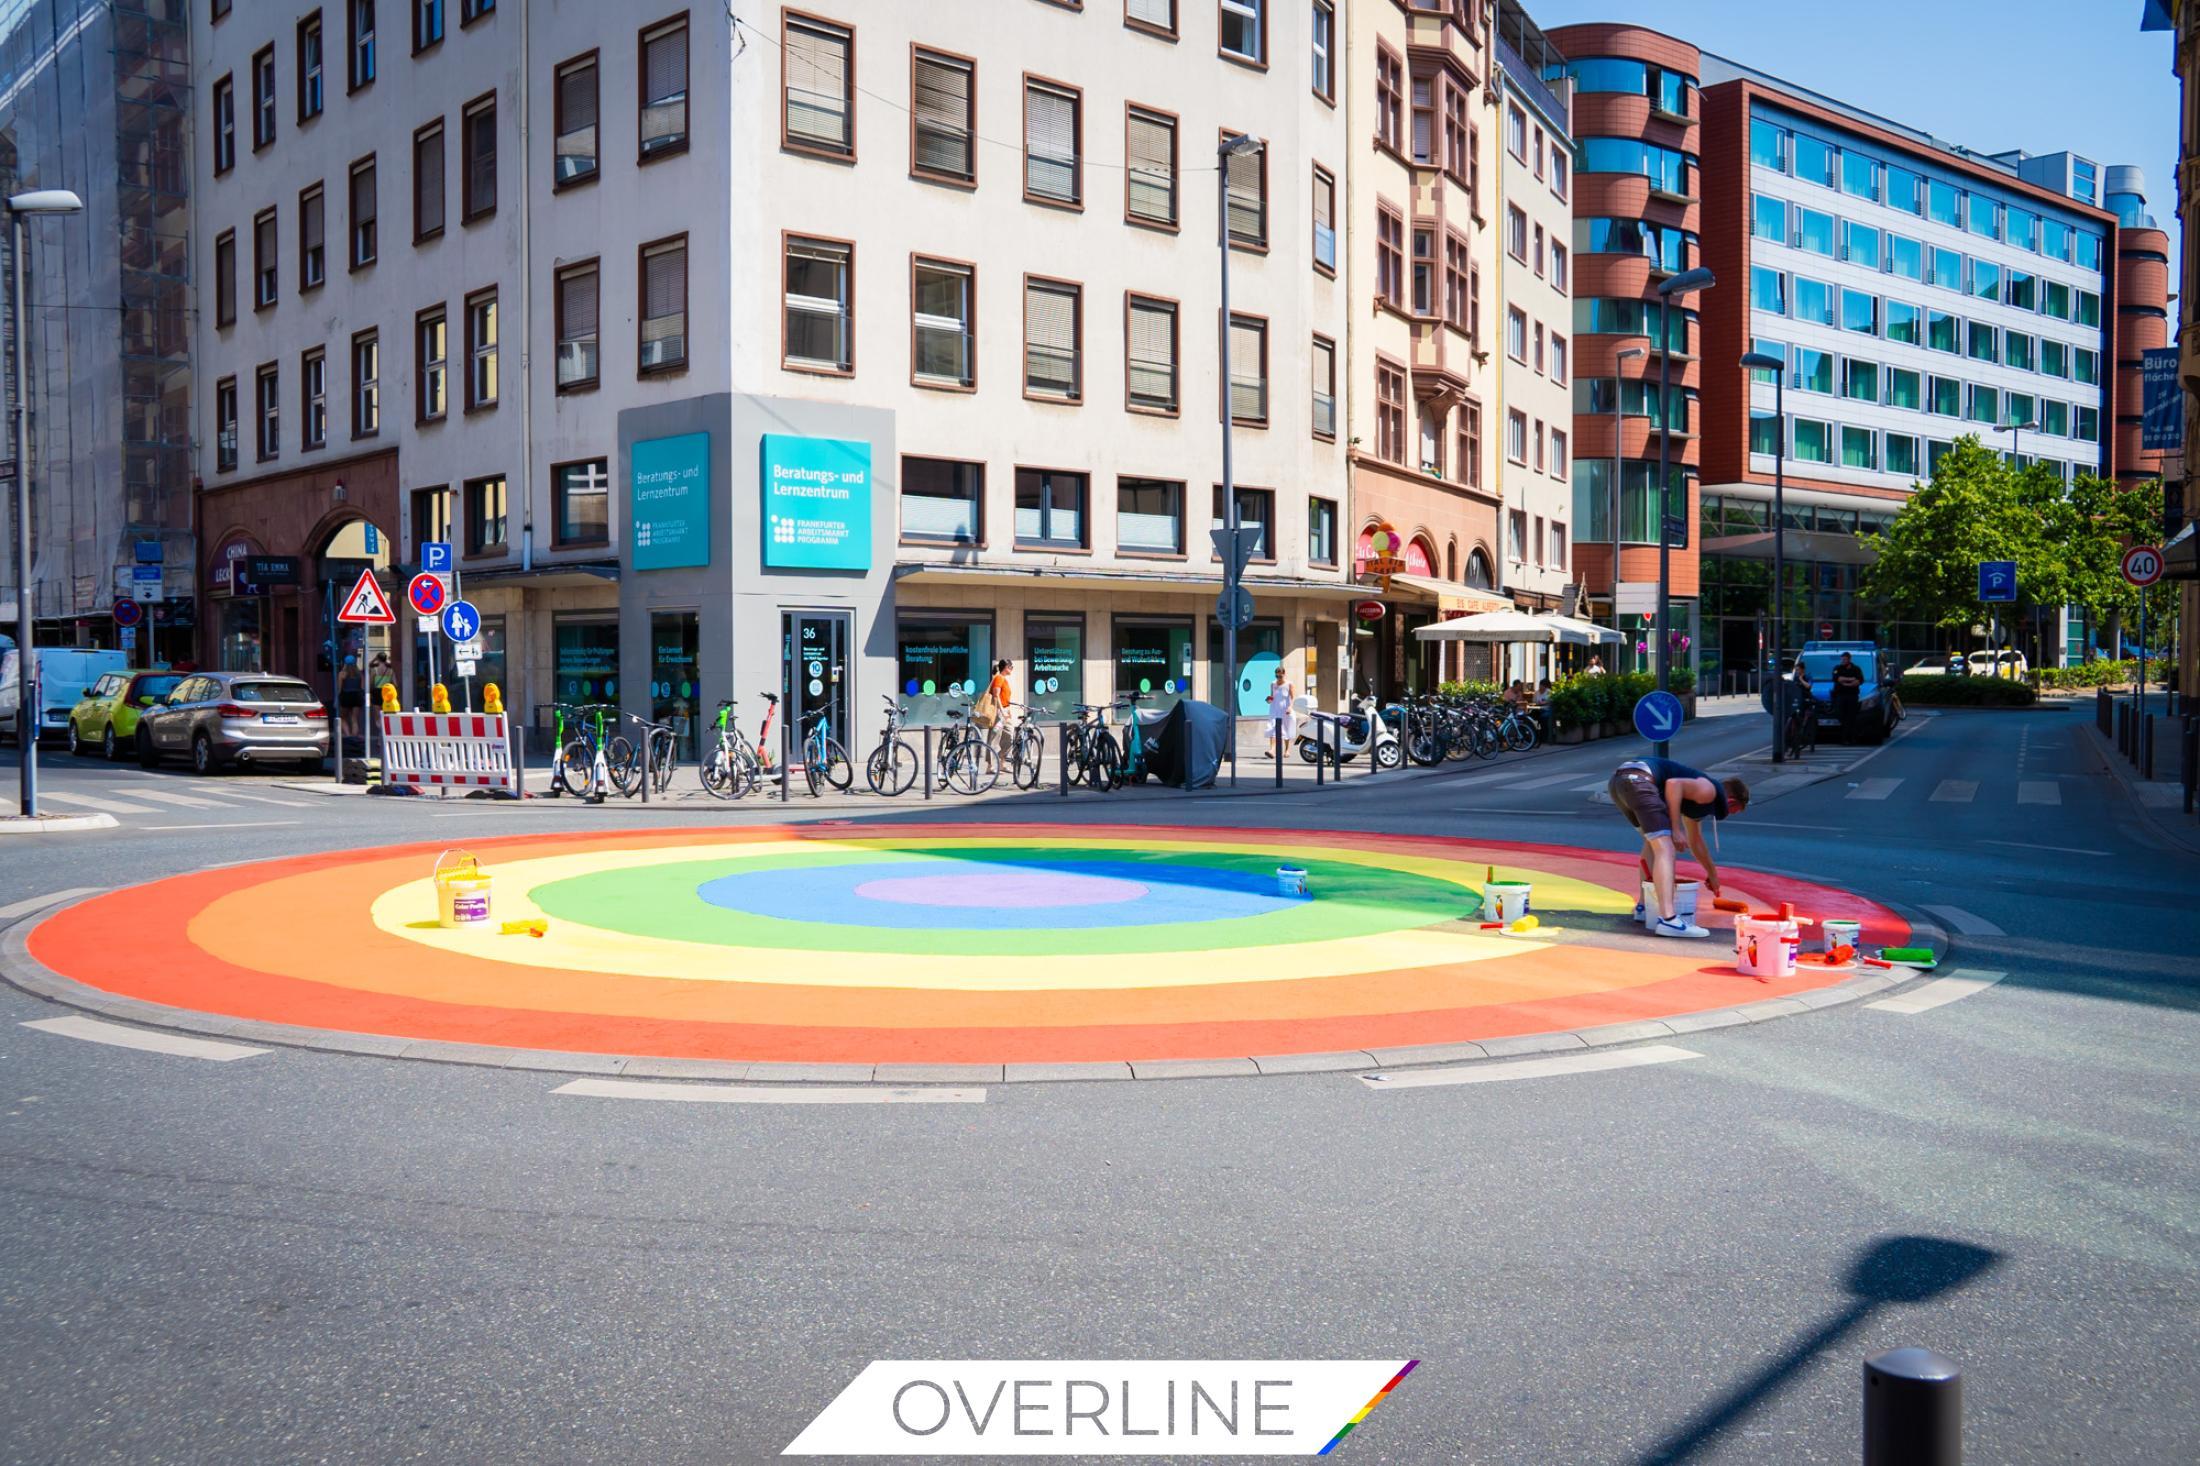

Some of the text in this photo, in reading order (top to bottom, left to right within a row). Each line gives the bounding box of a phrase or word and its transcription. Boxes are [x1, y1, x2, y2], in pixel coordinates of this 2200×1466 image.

[2144, 356, 2178, 370] Büro
[637, 464, 699, 485] Beratungs- und
[774, 464, 865, 484] Beratungs- und
[637, 485, 689, 501] Lernzentrum
[774, 481, 850, 499] Lernzentrum
[797, 520, 846, 529] FRANKFURTER
[226, 543, 248, 560] CHINA
[429, 547, 445, 568] P
[2130, 557, 2155, 575] 40
[1992, 577, 2003, 588] P
[803, 627, 816, 639] 36
[812, 664, 821, 672] 10
